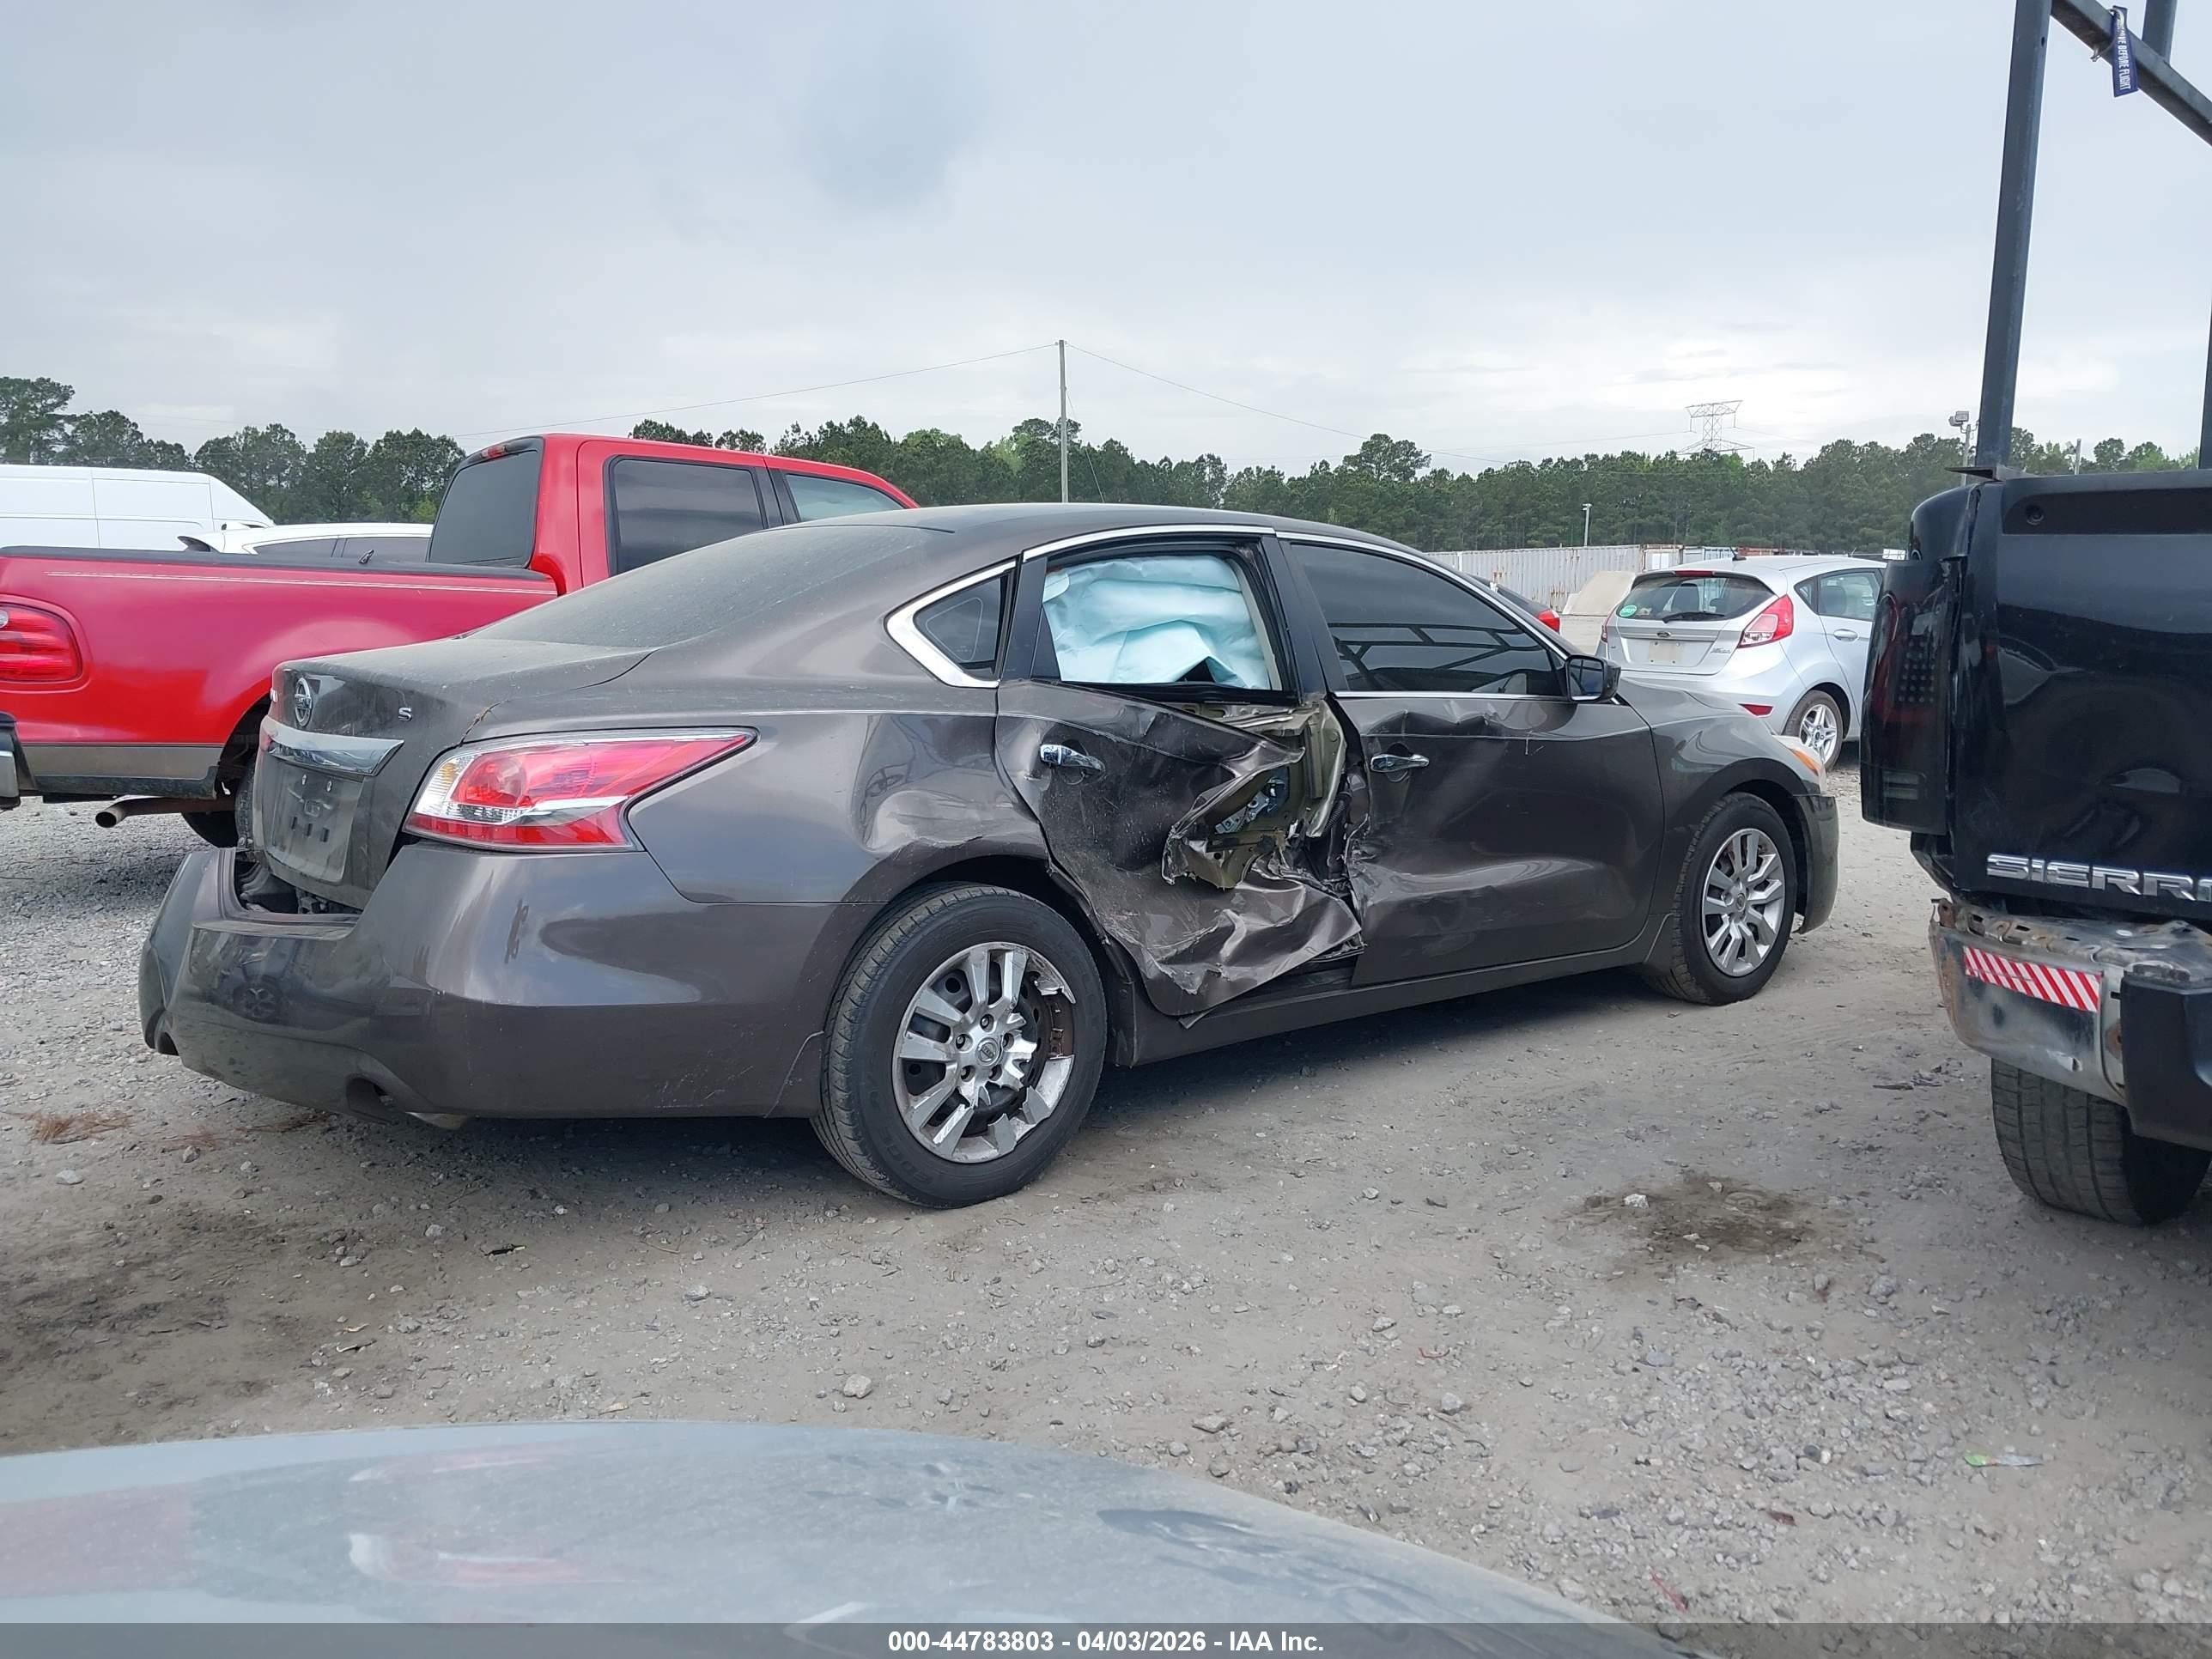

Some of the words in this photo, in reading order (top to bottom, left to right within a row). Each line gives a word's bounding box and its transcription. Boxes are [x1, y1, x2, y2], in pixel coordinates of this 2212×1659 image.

[2118, 45, 2130, 69] BEFORE
[2118, 69, 2131, 90] FLIGHT
[398, 707, 412, 721] S
[1986, 854, 2212, 902] SIERR
